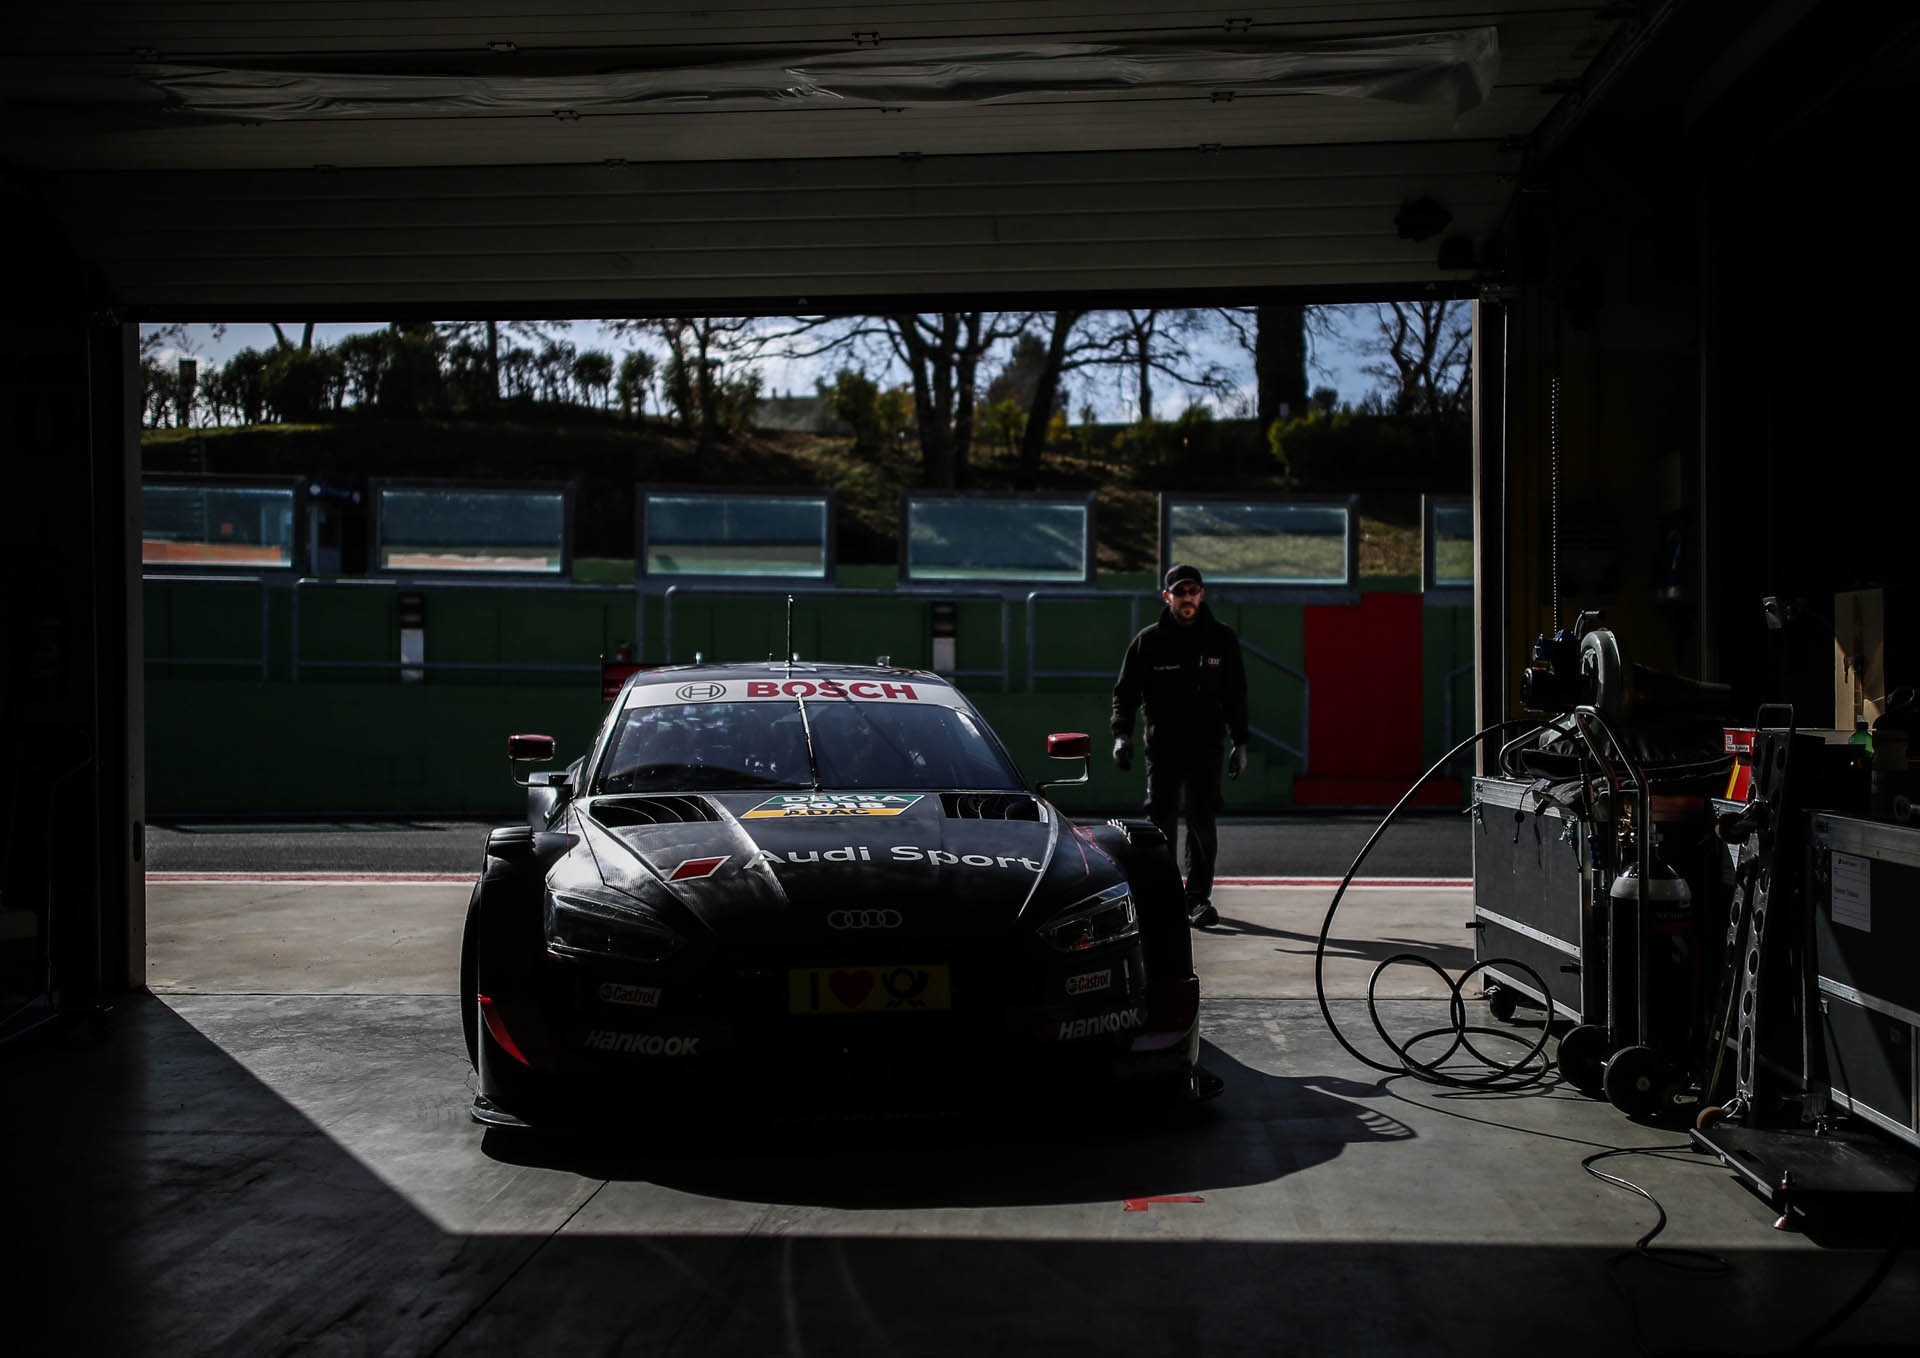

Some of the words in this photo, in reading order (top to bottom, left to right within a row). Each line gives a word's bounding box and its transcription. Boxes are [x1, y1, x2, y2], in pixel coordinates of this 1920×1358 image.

[747, 681, 918, 700] BOSCH
[743, 846, 871, 869] Audi
[889, 846, 1044, 873] Sport
[1078, 973, 1109, 991] Castrol
[613, 987, 657, 1004] Castrol
